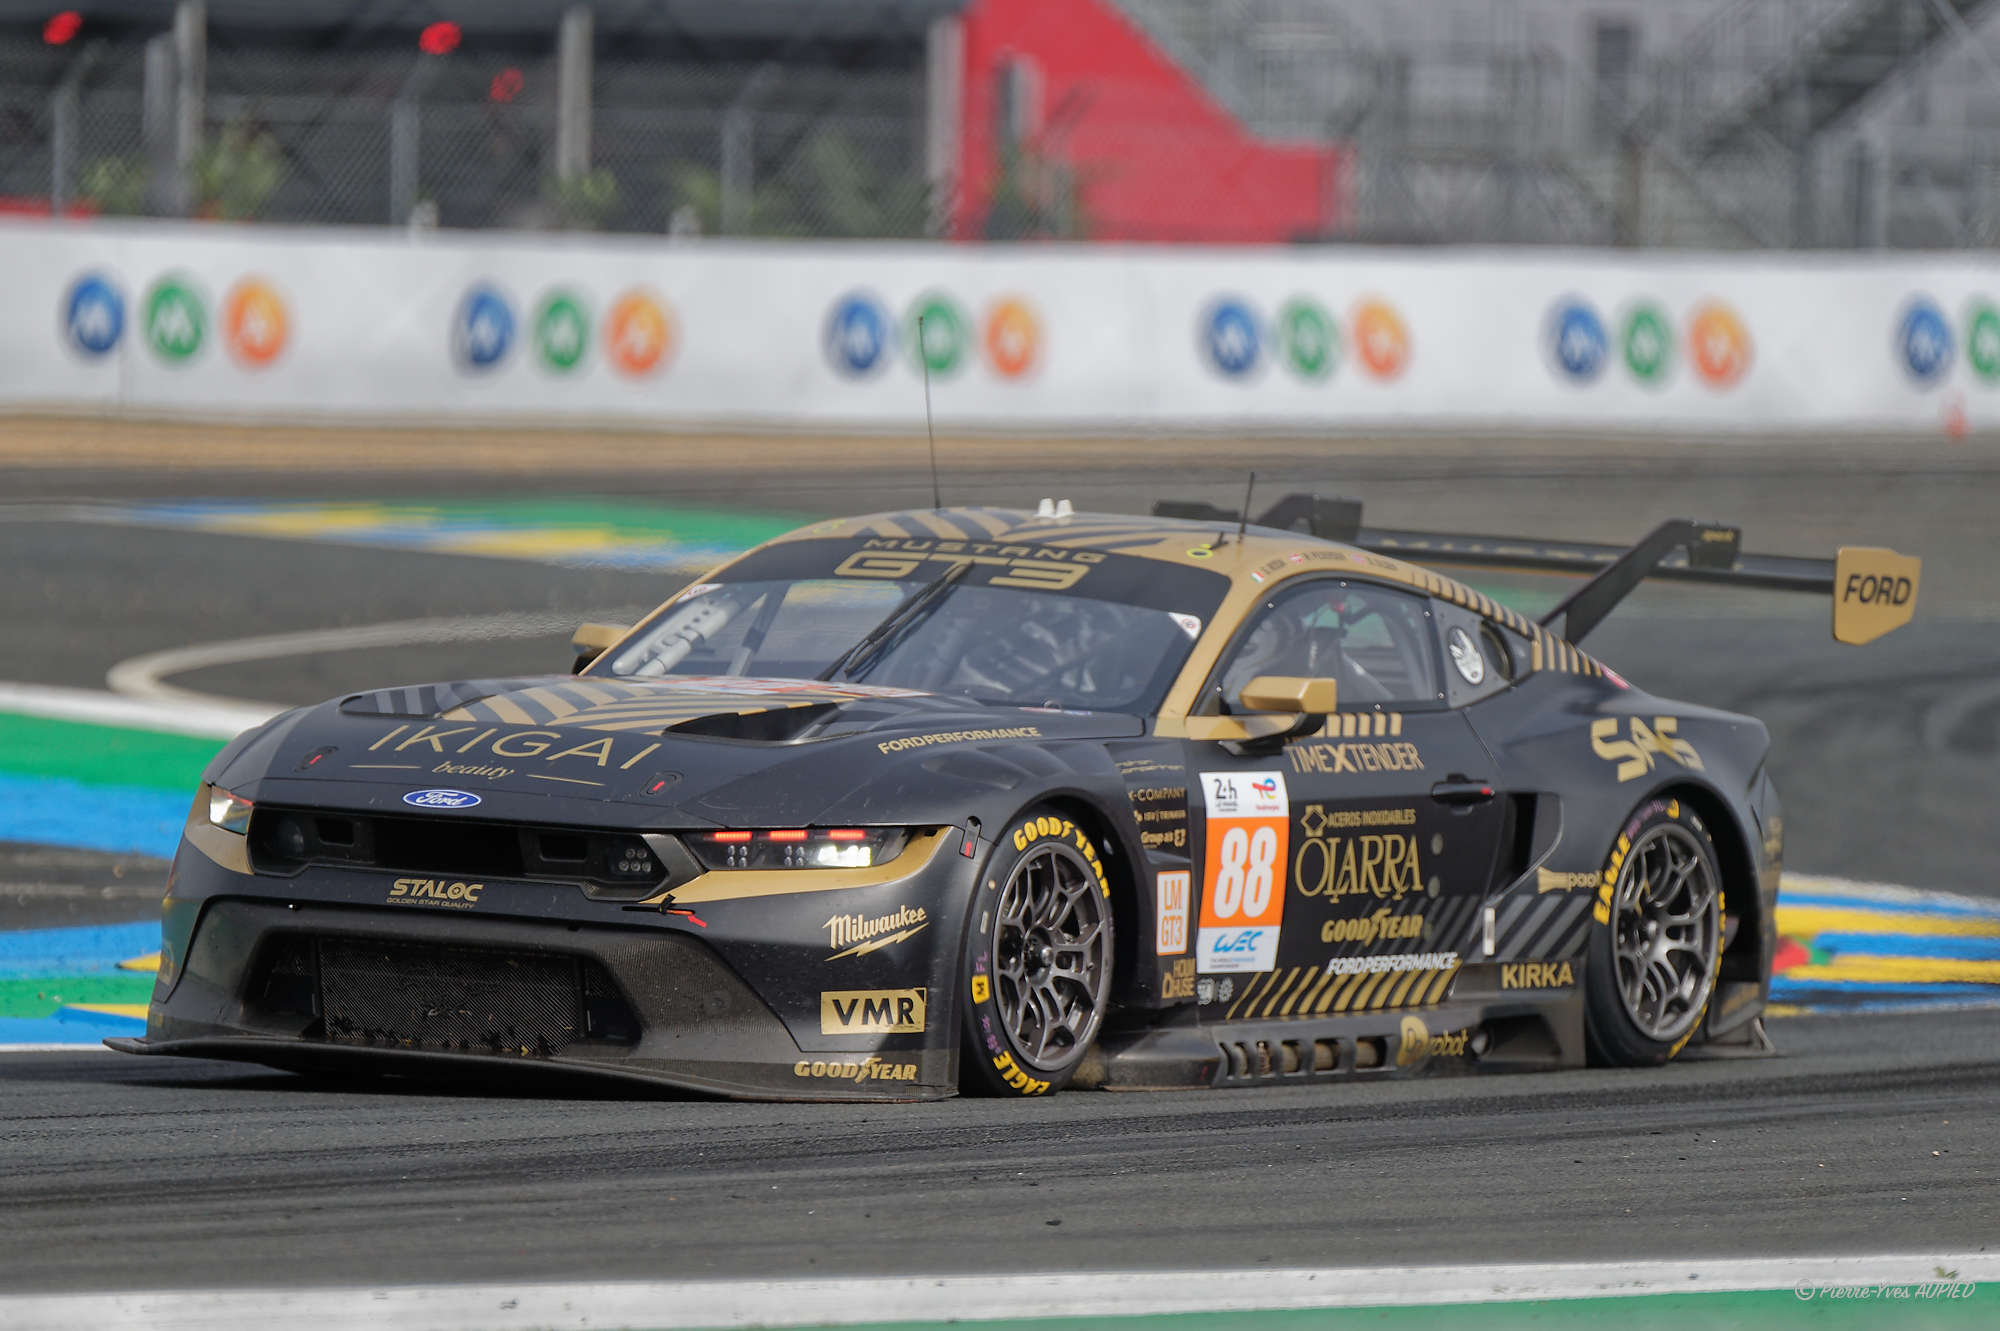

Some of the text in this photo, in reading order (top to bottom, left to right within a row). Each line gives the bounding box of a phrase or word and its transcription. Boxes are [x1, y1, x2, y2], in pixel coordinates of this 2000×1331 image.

[862, 538, 1107, 564] MUSTANG
[834, 550, 1091, 591] GT3
[1843, 574, 1912, 606] FORD
[367, 724, 662, 770] IKIGAI
[1283, 742, 1425, 774] TIMEXTENDER
[431, 760, 515, 780] beauty
[1213, 826, 1277, 919] 88
[389, 878, 484, 902] STALOC
[441, 901, 475, 910] QUALITY
[1164, 879, 1183, 910] LM
[822, 905, 928, 950] Milwaukee
[1161, 915, 1184, 947] GT3
[1213, 930, 1264, 953] WEC
[1321, 907, 1424, 947] GOODYEAR
[1501, 961, 1575, 990] KIRKA
[832, 997, 915, 1026] VMR
[793, 1057, 918, 1084] GOODYEAR
[992, 1049, 1051, 1097] EAGLE
